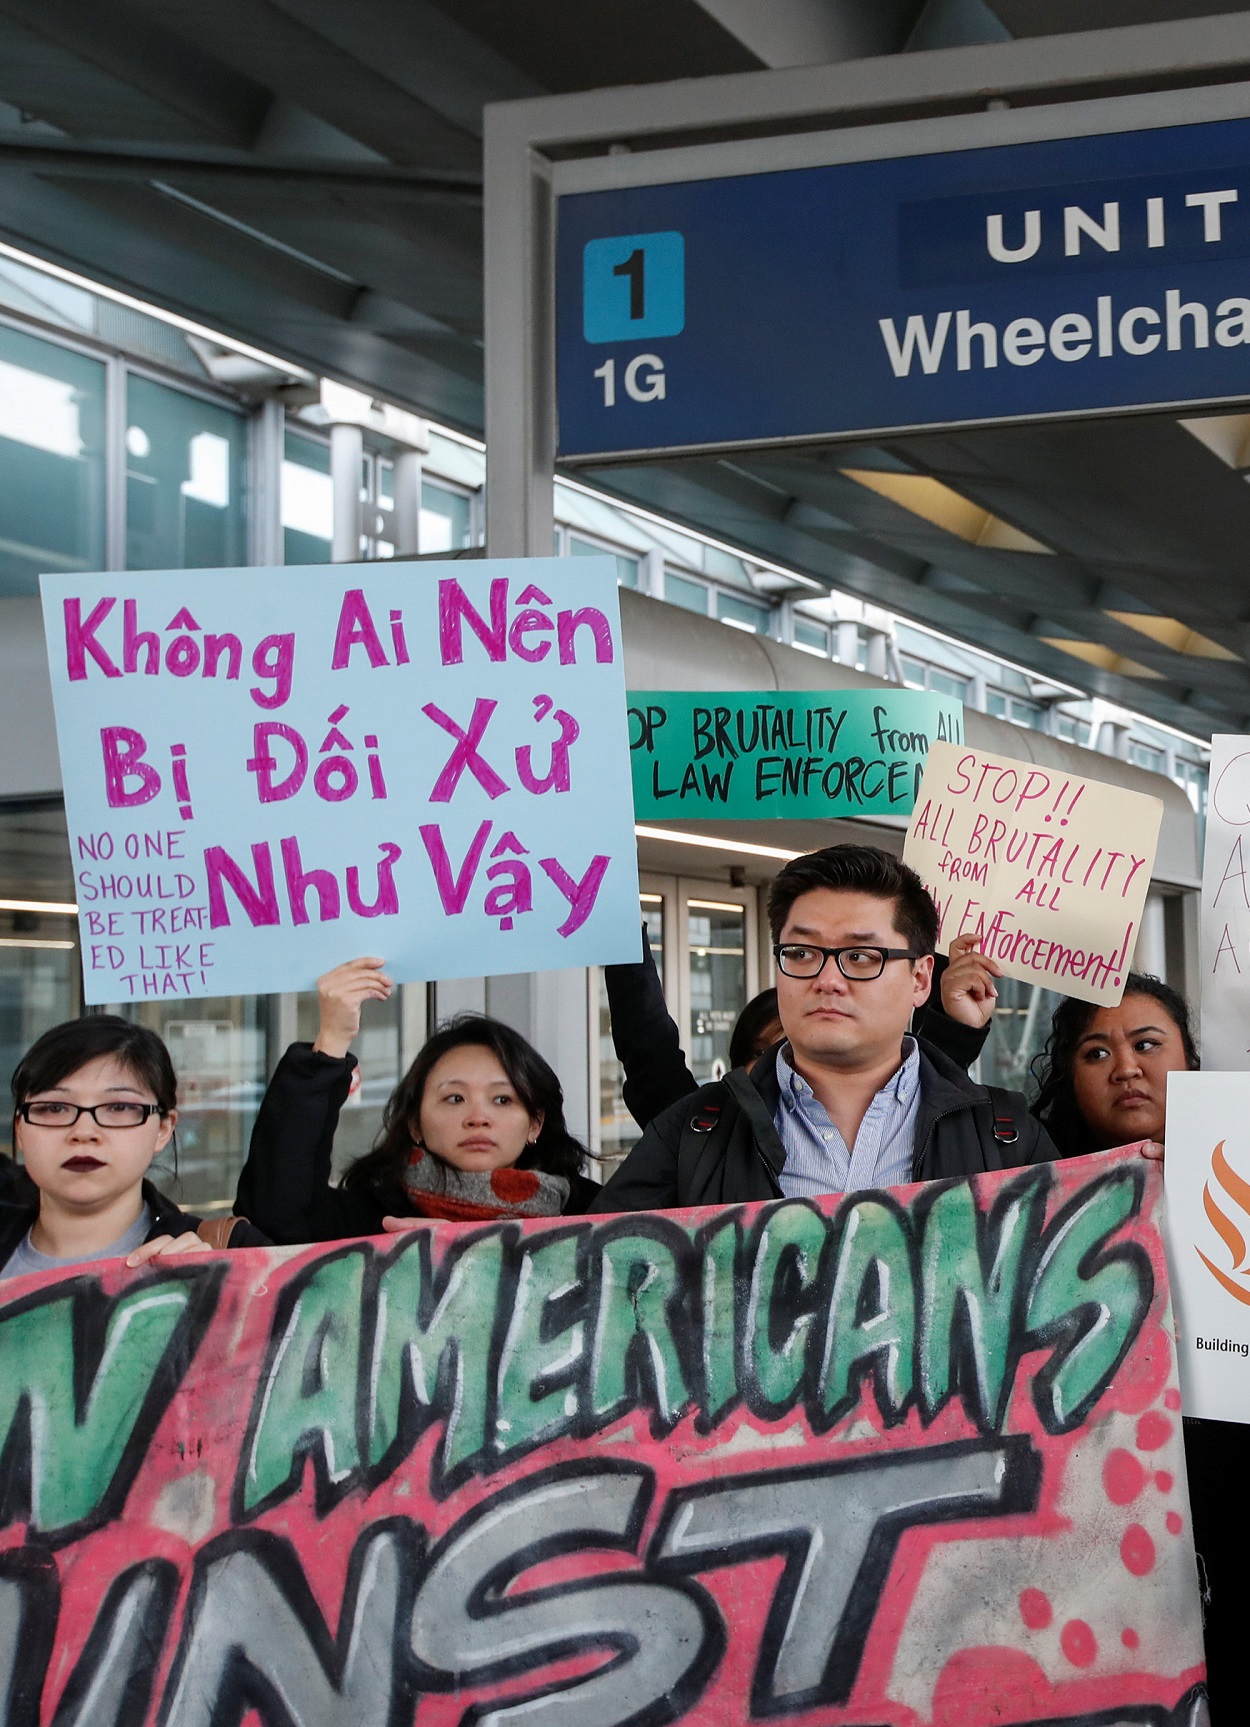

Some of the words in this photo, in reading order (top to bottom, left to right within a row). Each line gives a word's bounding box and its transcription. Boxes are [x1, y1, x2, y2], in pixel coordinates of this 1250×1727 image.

[612, 248, 645, 320] 1
[594, 353, 667, 407] 1G
[63, 597, 295, 709] Không
[331, 589, 410, 670] Ai
[437, 577, 614, 666] Nên
[101, 726, 194, 821] Bị
[247, 704, 388, 802] Đối
[421, 694, 580, 803] Xử
[693, 705, 848, 760] BRUTALITY
[871, 705, 929, 754] from
[653, 760, 735, 802] LAW
[947, 754, 1086, 827] STOP!!
[78, 832, 115, 861] NO
[125, 830, 186, 860] ONE
[913, 799, 955, 847] ALL
[967, 813, 1146, 898] BRUTALITY
[79, 871, 196, 900] SHOULD
[204, 835, 402, 929] Như
[419, 820, 612, 938] Vậy
[1015, 878, 1062, 912] ALL
[85, 911, 125, 936] BE
[91, 945, 125, 970] ED
[140, 943, 215, 970] LIKE
[120, 970, 208, 996] THAT!
[231, 1161, 1155, 1523] AMERICANS
[1196, 1336, 1249, 1357] Building
